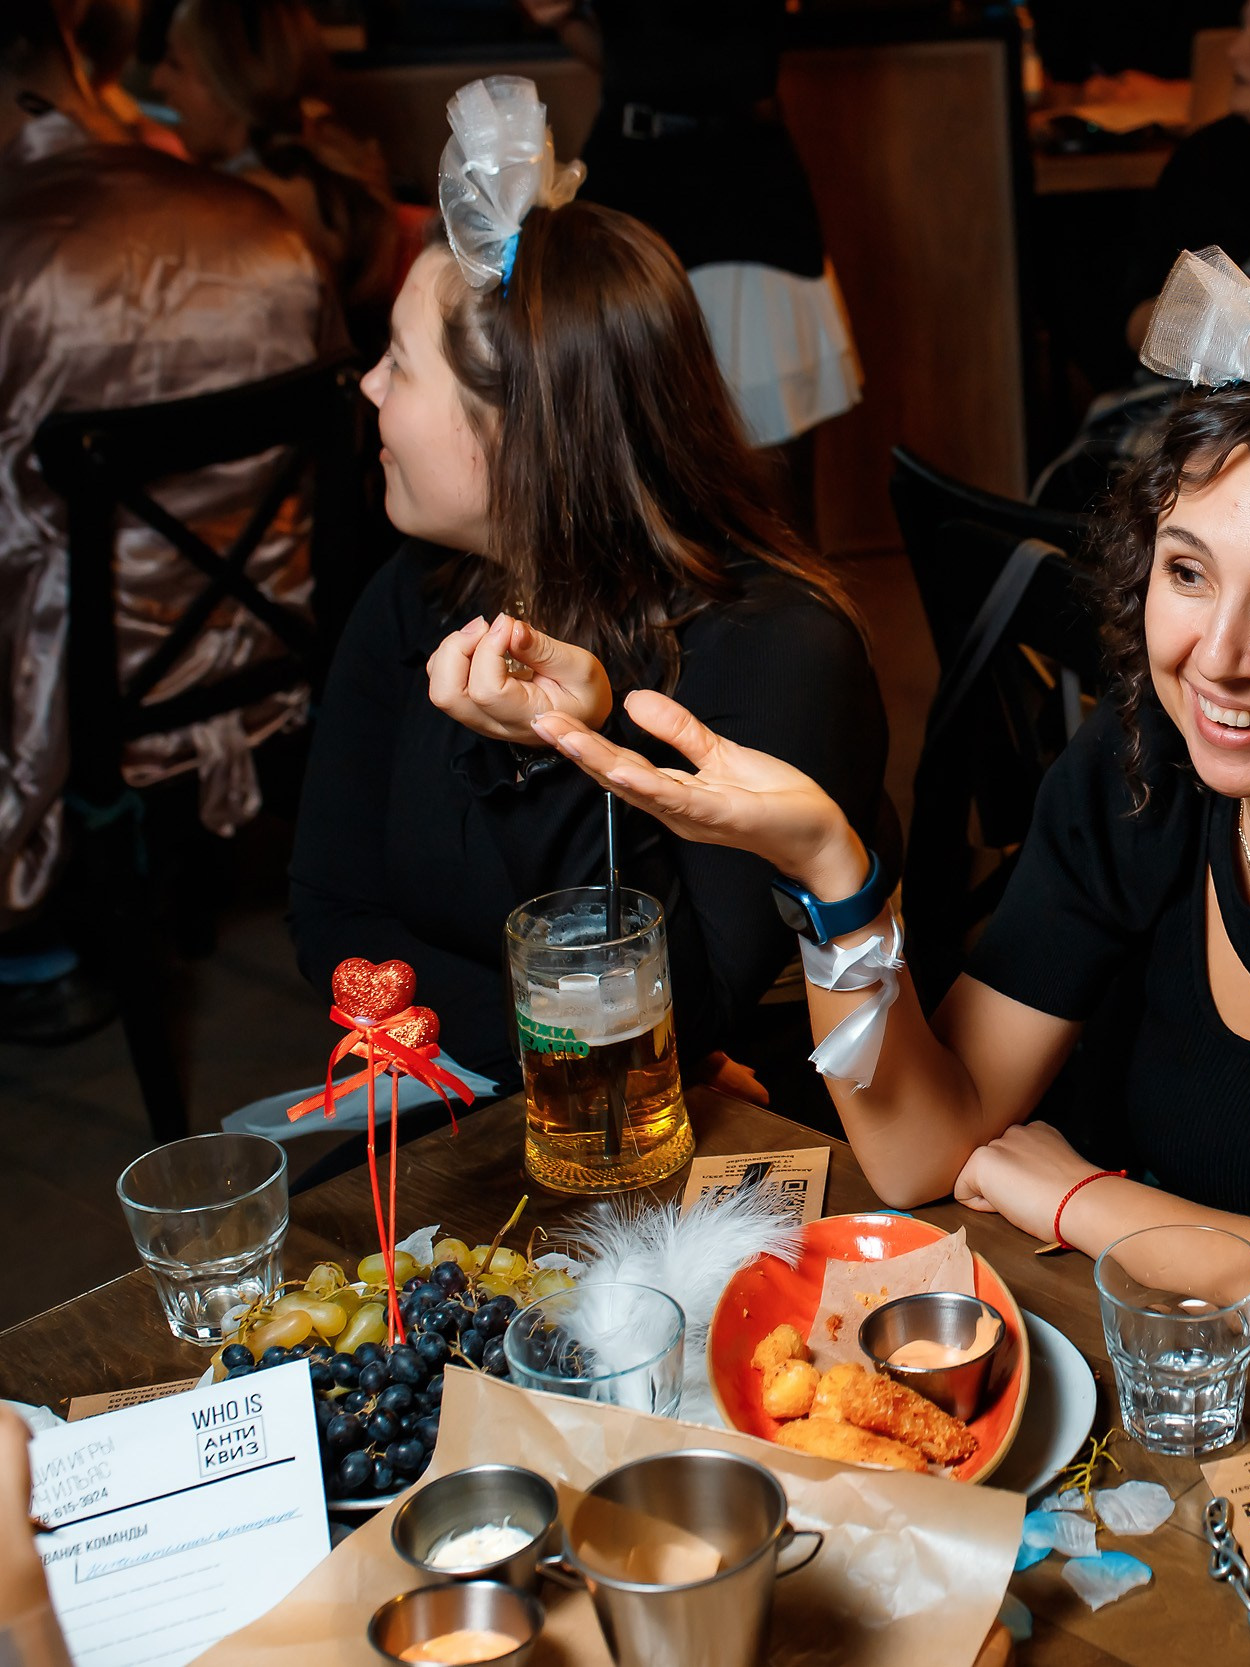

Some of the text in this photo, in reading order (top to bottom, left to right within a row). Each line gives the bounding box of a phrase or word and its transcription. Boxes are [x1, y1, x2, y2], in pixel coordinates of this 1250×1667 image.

[191, 1393, 263, 1430] WHO IS
[204, 1424, 256, 1451] АНТИ
[205, 1441, 259, 1468] КВИЗ
[40, 1524, 148, 1566] ВАНИЕ КОМАНДЫ
